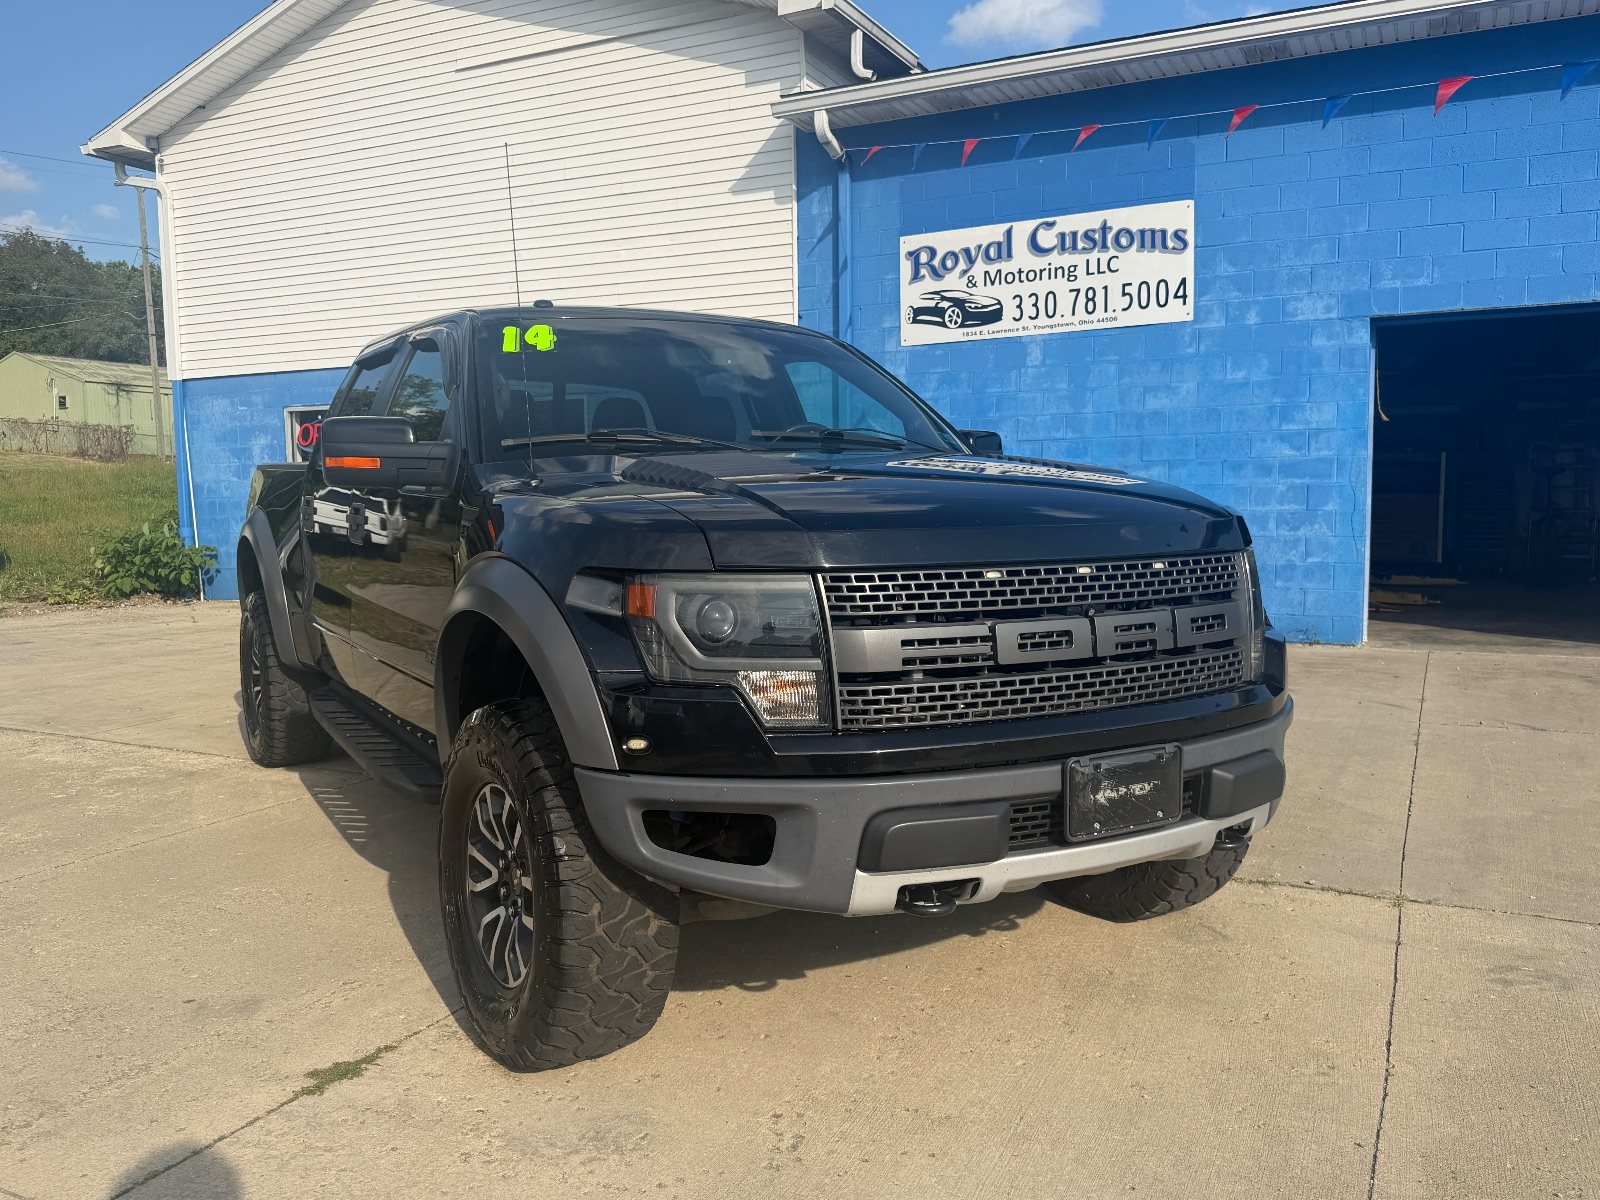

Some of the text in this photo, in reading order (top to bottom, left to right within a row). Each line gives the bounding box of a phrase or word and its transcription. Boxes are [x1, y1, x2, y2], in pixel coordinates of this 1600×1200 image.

[906, 219, 1189, 285] Royal Customs
[965, 255, 1120, 289] & Motoring LLC
[1011, 277, 1188, 322] 330.781.5004
[502, 324, 557, 353] 14
[987, 327, 1020, 335] Lawrence
[1033, 321, 1077, 331] Youngstown,
[834, 601, 1243, 673] FORD
